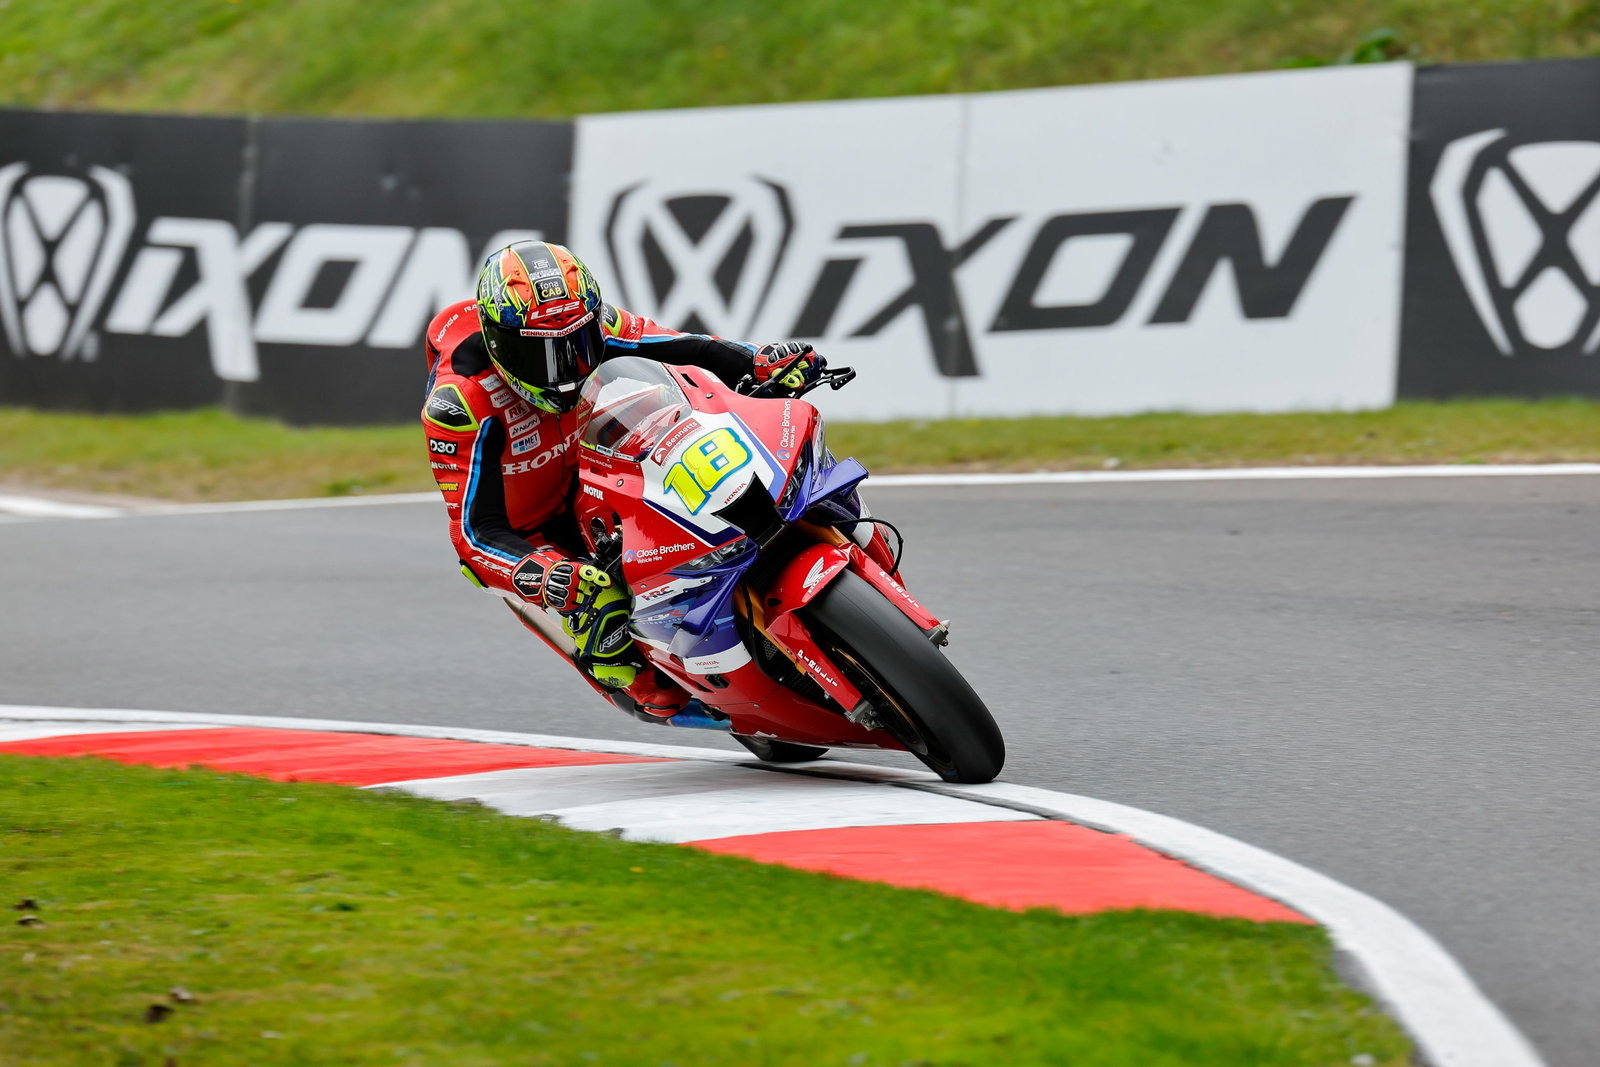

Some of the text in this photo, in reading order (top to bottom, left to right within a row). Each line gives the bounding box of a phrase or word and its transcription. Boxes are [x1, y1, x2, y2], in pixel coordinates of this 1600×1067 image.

[541, 287, 562, 298] CAB
[530, 300, 580, 320] LS2
[435, 313, 459, 342] Honda
[556, 320, 584, 337] ROOFING
[430, 396, 468, 416] RST
[508, 402, 526, 419] RK
[780, 399, 792, 448] Close Brothers
[524, 433, 538, 447] MET
[665, 421, 698, 448] Bennetts
[502, 420, 590, 475] HOND
[663, 427, 753, 516] 18
[583, 484, 604, 501] MOTUL
[723, 482, 747, 505] HONDA
[636, 542, 696, 558] Close Brothers
[515, 572, 543, 581] RST
[807, 564, 839, 594] HONDA
[641, 585, 674, 601] HRC
[879, 571, 920, 608] PIRELLI
[797, 649, 838, 687] PIRELLI
